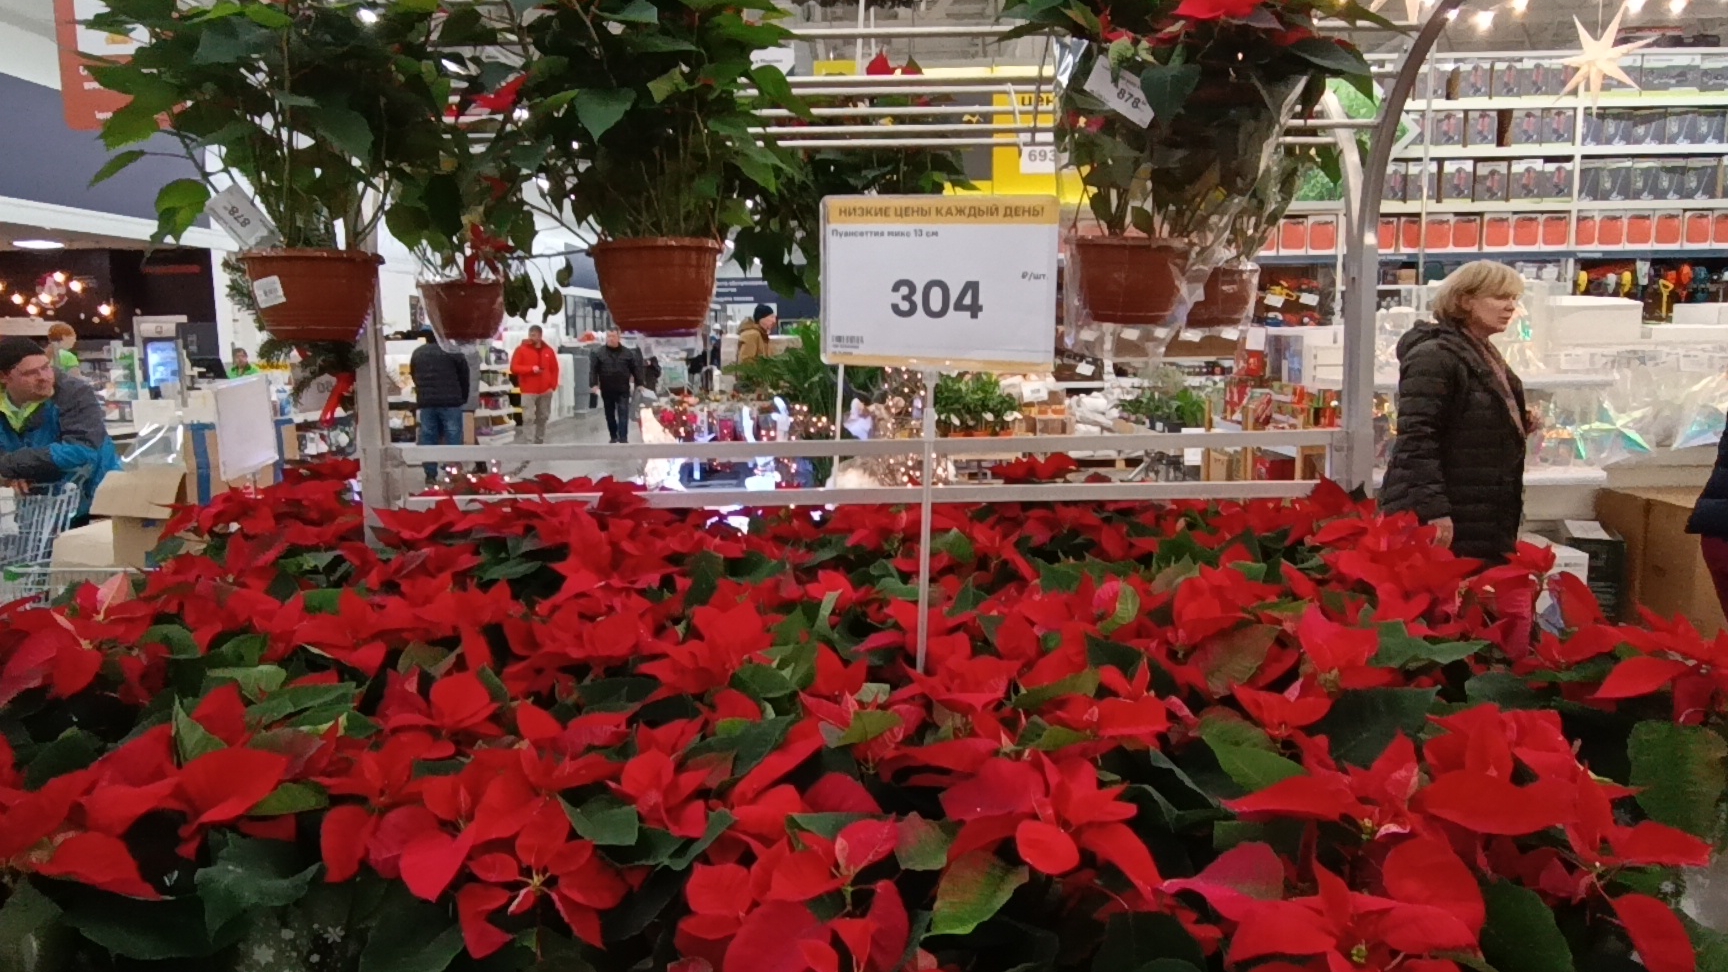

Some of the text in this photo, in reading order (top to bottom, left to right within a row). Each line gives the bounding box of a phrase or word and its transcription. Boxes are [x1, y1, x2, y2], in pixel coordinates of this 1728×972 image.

[1117, 88, 1141, 109] 878
[228, 205, 251, 228] 878
[838, 203, 1045, 219] НИЗКИЕ ЦЕНЫ КАЖДЫЙ ДЕНЬ!
[887, 230, 911, 238] микс
[914, 228, 923, 238] 13
[925, 230, 939, 238] см
[890, 279, 983, 319] 304
